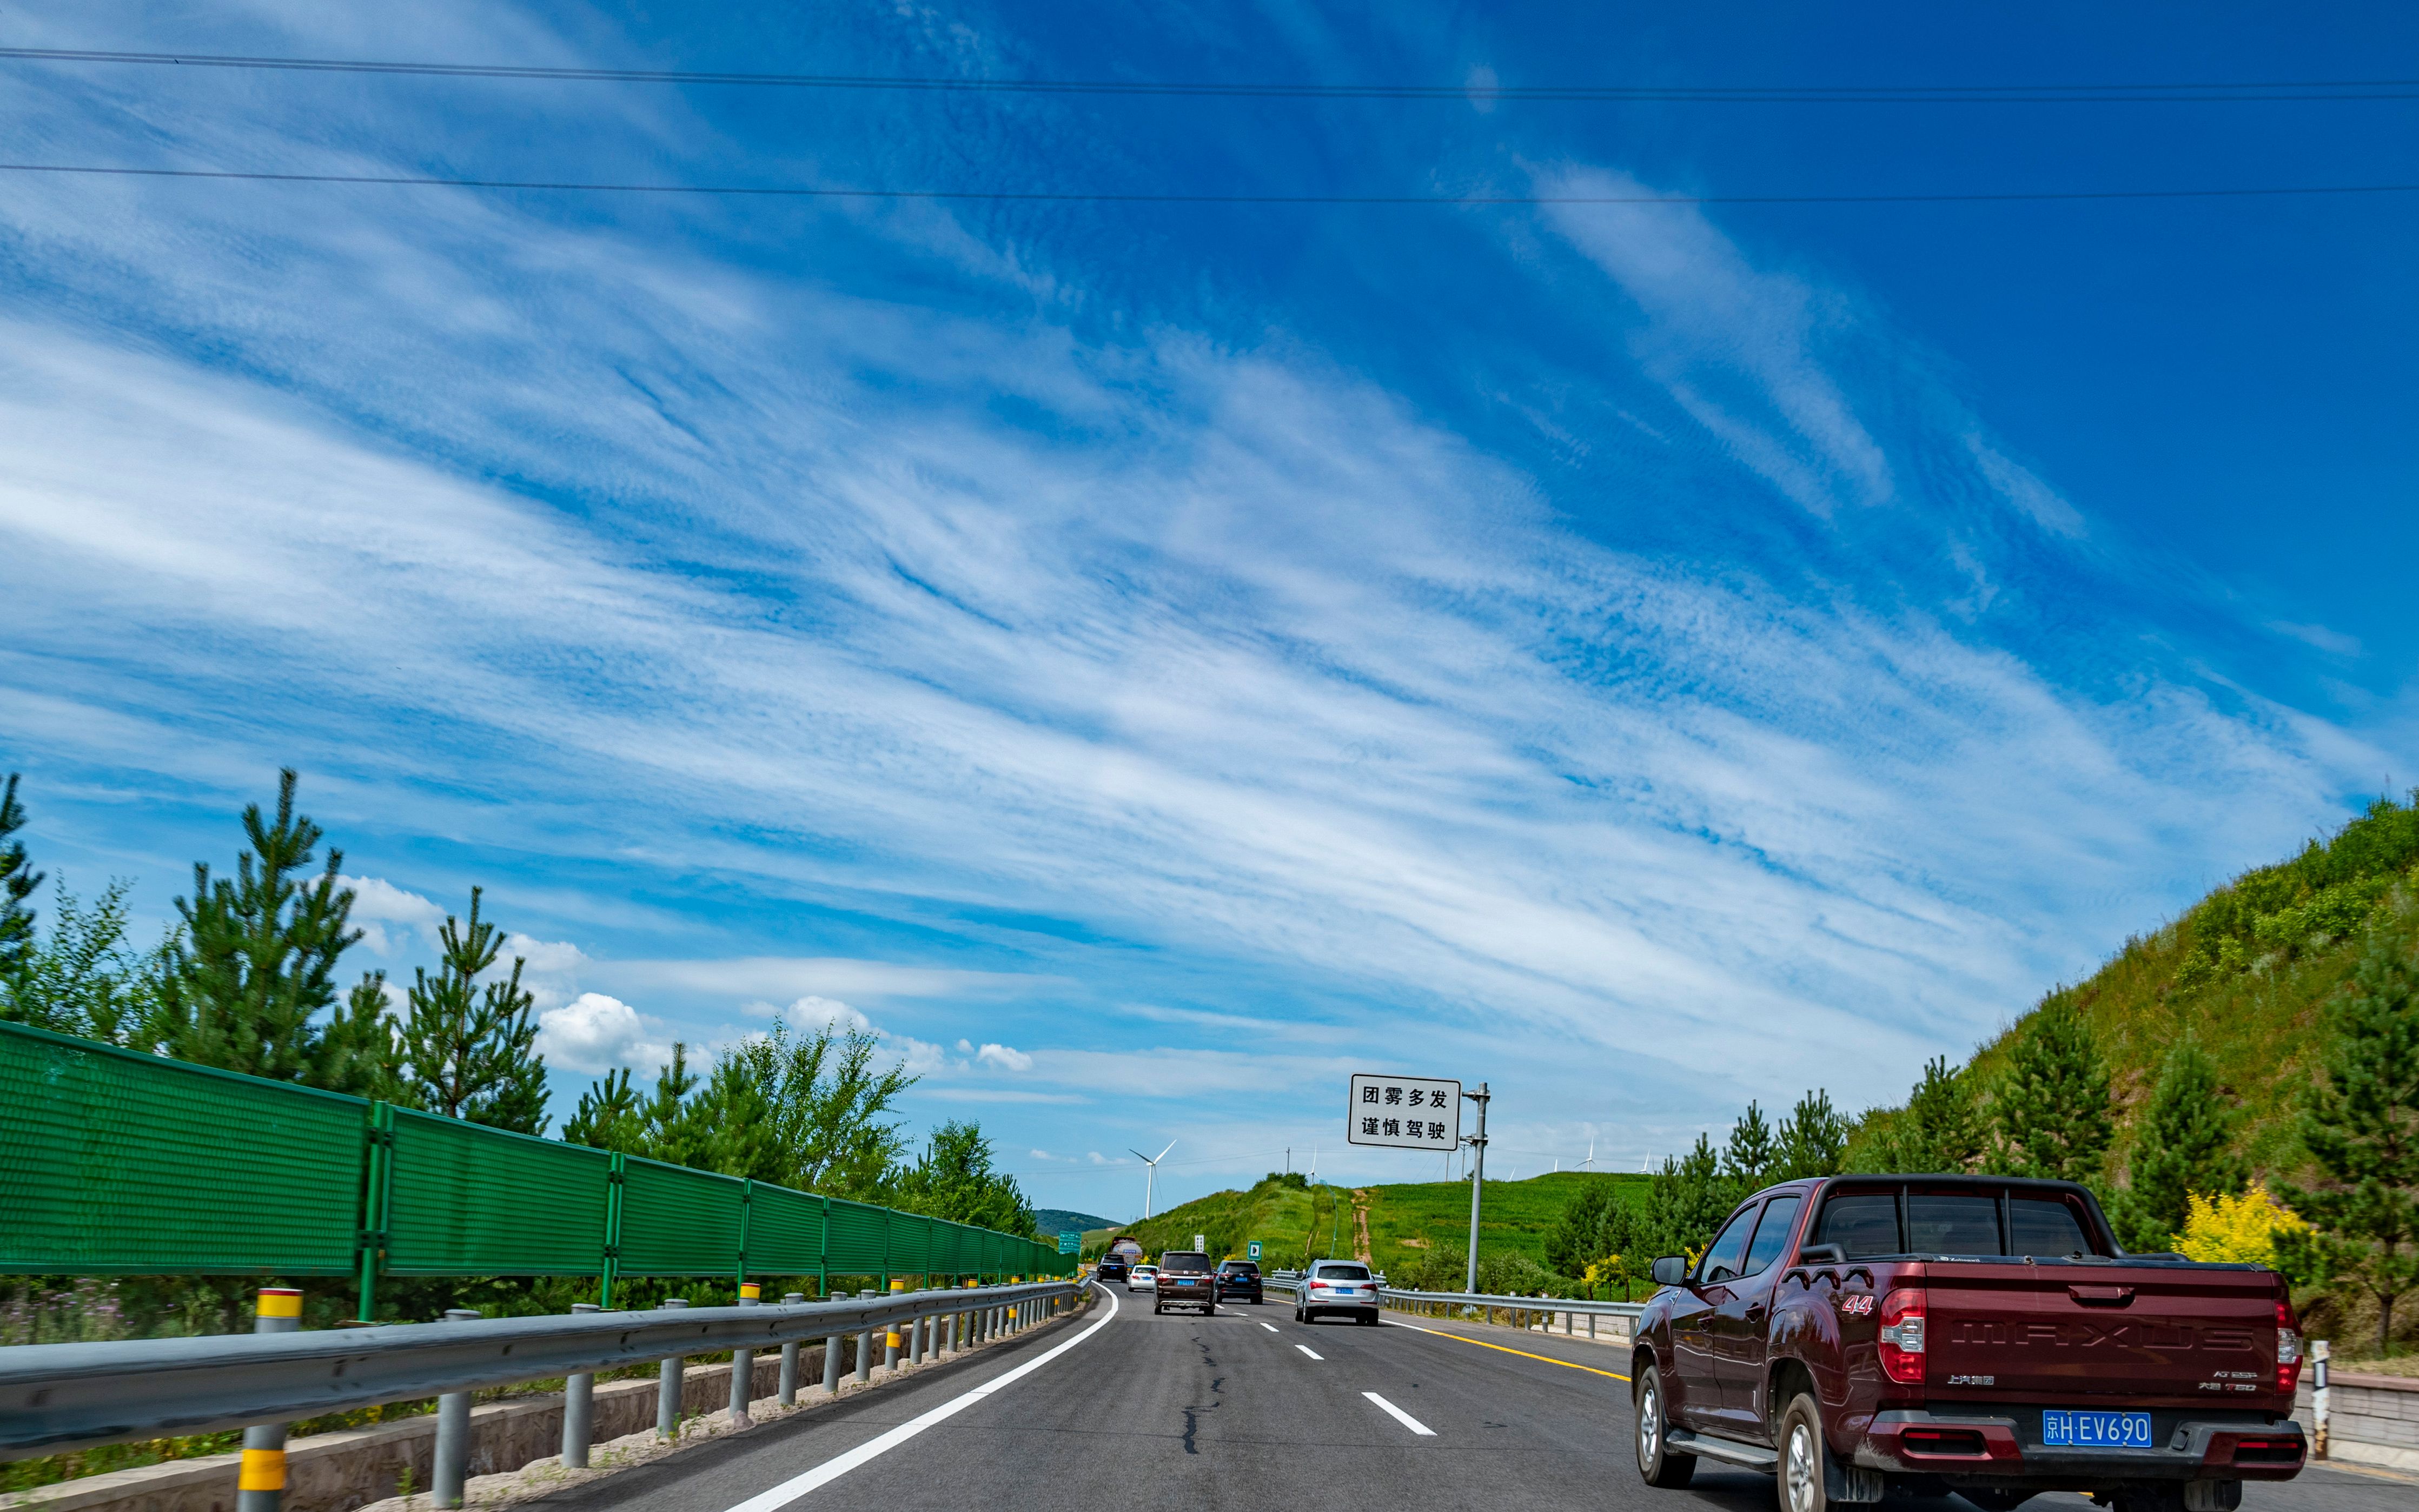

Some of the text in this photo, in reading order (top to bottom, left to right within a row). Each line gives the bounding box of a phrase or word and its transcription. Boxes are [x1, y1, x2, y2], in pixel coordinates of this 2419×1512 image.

[1363, 1086, 1447, 1109] 团雾多发
[1362, 1117, 1446, 1140] 谨慎驾驶
[1951, 1319, 2254, 1351] MAXUS
[1947, 1375, 1994, 1385] 上汽集团
[2225, 1383, 2257, 1391] T60
